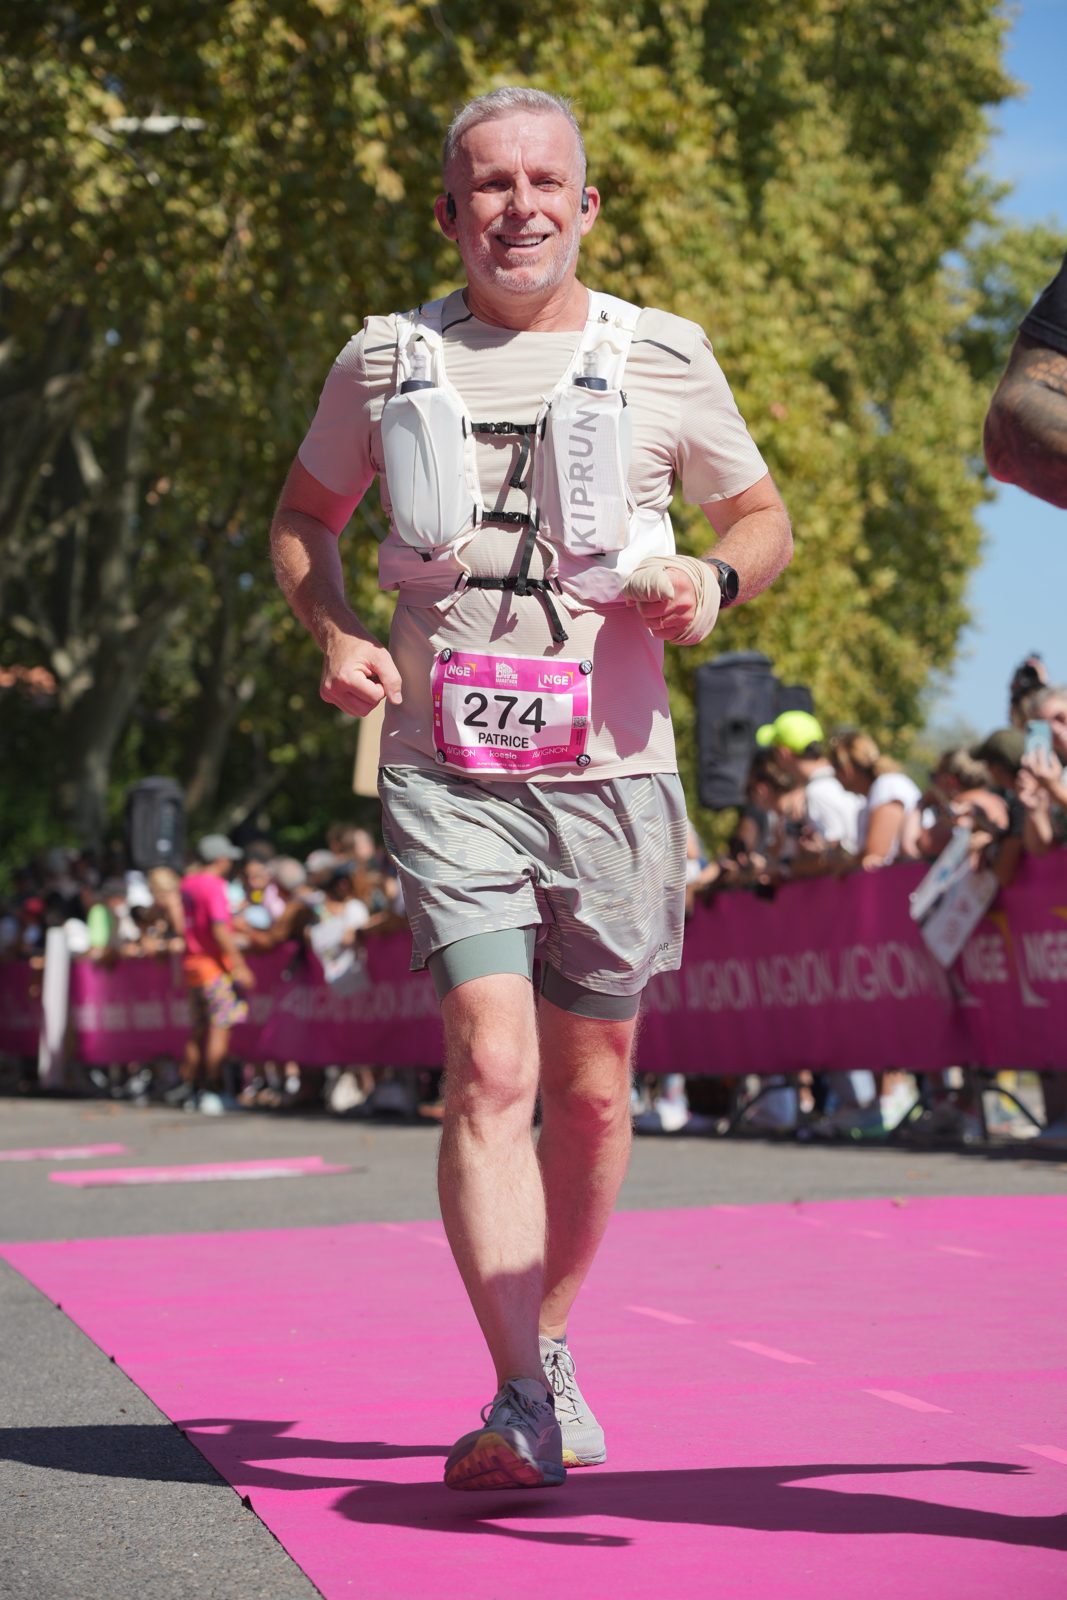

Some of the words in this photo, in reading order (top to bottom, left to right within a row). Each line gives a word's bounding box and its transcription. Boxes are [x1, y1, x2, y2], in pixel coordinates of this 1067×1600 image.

[568, 410, 601, 549] KIPRUN
[448, 664, 471, 677] NGE
[543, 674, 569, 686] NGE
[463, 692, 547, 733] 274
[478, 732, 529, 749] PATRICE
[446, 746, 476, 758] AVIGNON
[532, 746, 568, 759] AVIGNON
